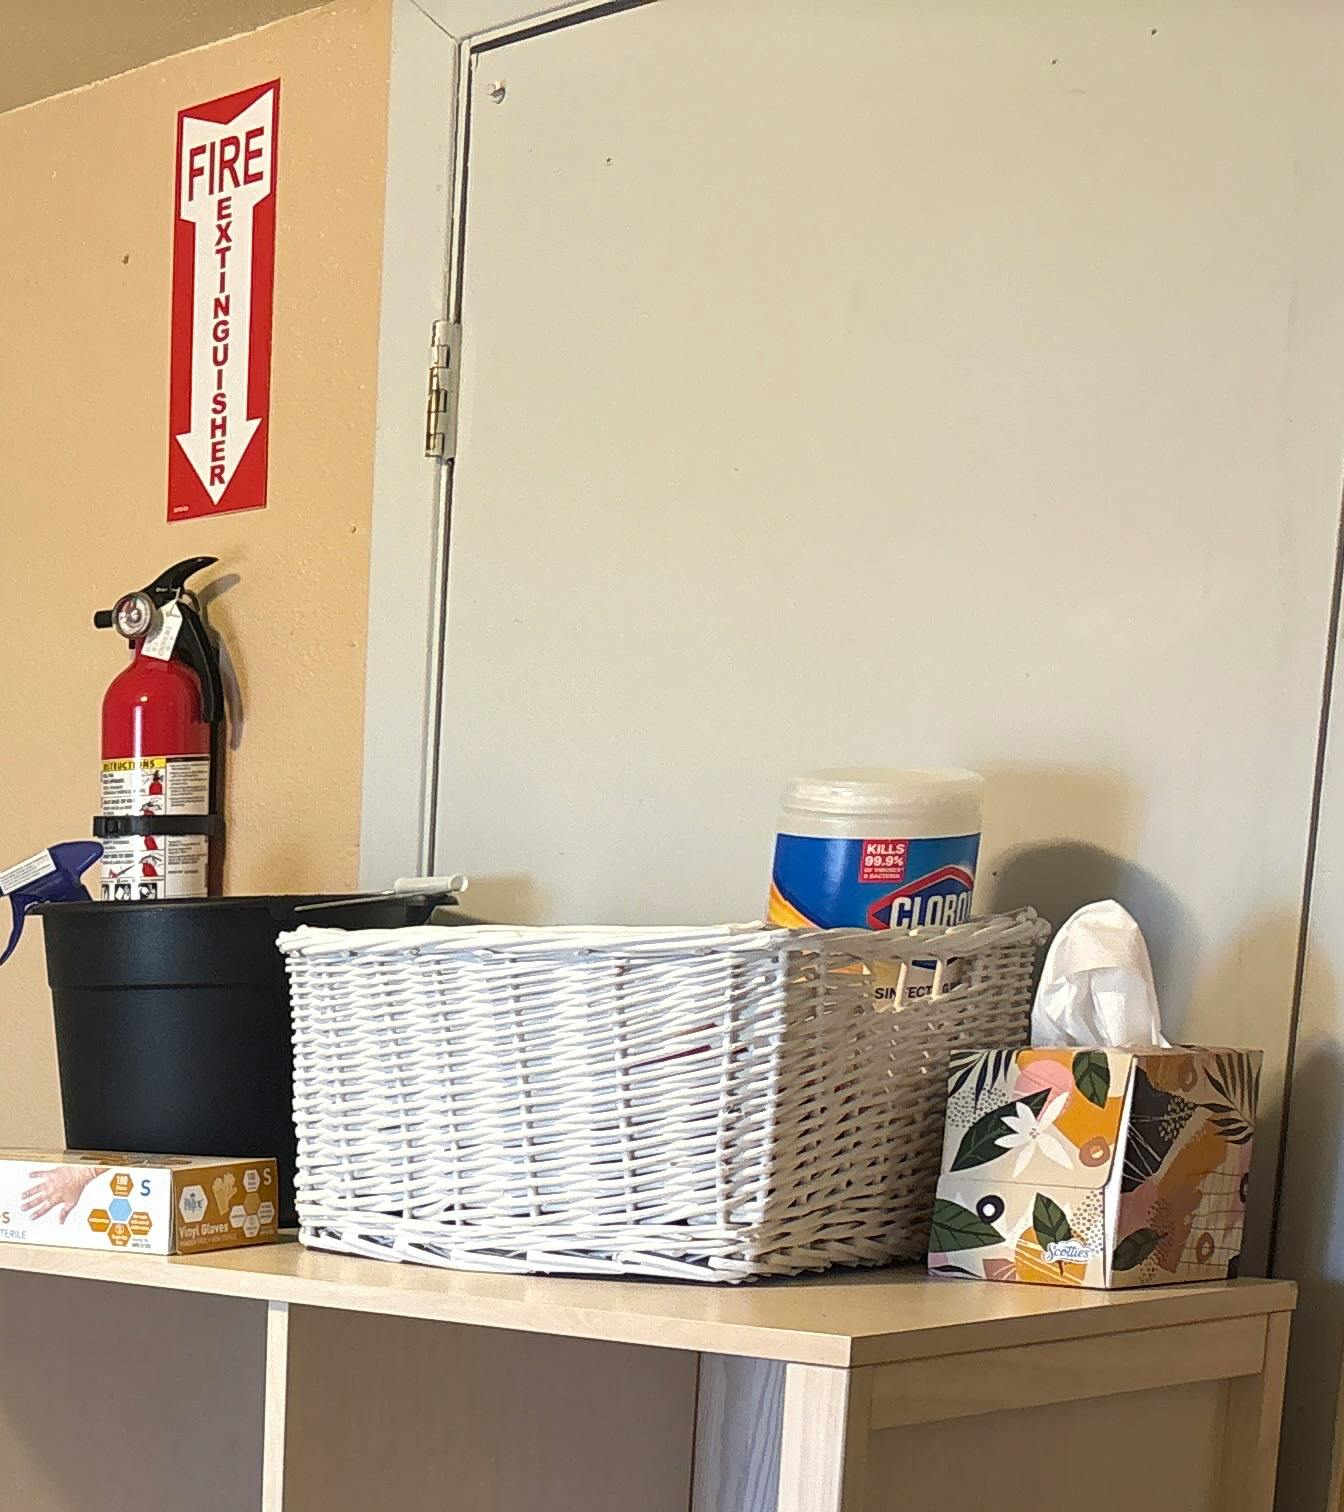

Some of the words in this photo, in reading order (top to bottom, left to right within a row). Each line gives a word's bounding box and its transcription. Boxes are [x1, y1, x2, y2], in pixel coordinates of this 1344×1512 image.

[188, 125, 265, 202] FIRE
[209, 195, 233, 487] EXTINGUISHER
[866, 843, 905, 855] KILLS
[864, 855, 904, 867] 99.9%
[263, 1168, 272, 1186] S
[140, 1179, 151, 1197] S
[178, 1224, 200, 1239] Vinyl
[201, 1222, 229, 1236] Gloves
